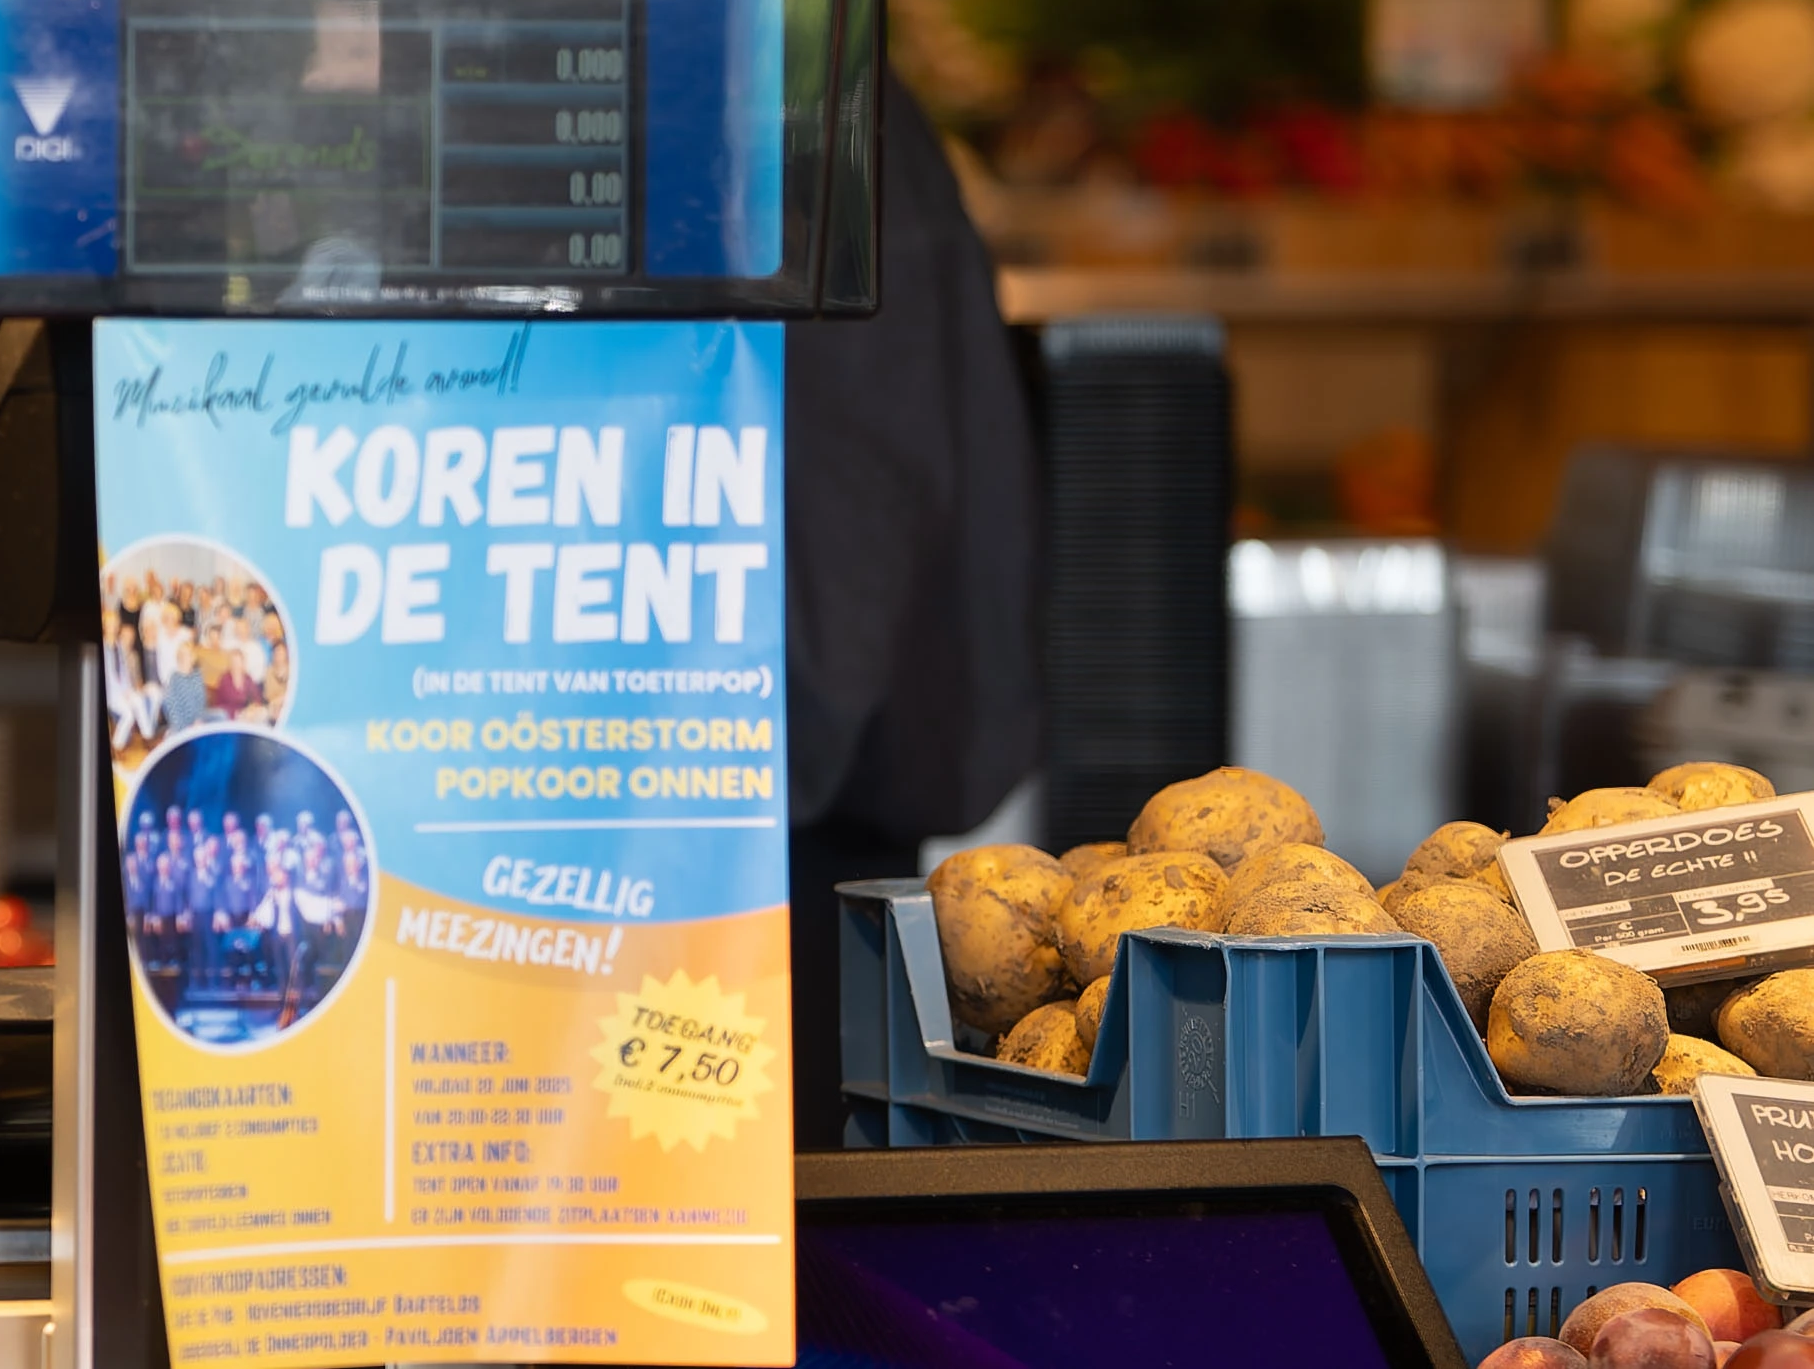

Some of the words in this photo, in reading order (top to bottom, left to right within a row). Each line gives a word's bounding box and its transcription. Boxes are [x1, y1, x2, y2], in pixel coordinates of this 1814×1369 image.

[556, 48, 622, 81] 0.000
[555, 110, 622, 144] 0.000
[569, 171, 622, 206] 0.00
[568, 233, 622, 267] 0.00
[284, 425, 626, 527] KOREN
[662, 425, 767, 527] IN
[315, 544, 450, 646] DE
[485, 544, 768, 644] TENT
[412, 667, 447, 698] (IN
[452, 671, 483, 693] DE
[488, 670, 547, 693] TENT
[553, 670, 607, 693] VAN
[612, 667, 772, 698] TOETERPOP)
[367, 721, 473, 753] KOOR
[481, 712, 773, 753] OÖSTERSTORM
[437, 767, 621, 801] POPKOOR
[629, 766, 773, 799] ONNEN
[1560, 820, 1784, 868] OPPERDOES
[482, 854, 655, 917] GEZELLIG
[1605, 868, 1642, 887] DE
[1651, 854, 1735, 878] ECHTE
[1692, 888, 1791, 925] 3,95
[397, 906, 624, 975] MEEZINGEN!
[1595, 935, 1612, 943] Per
[1637, 927, 1665, 937] gram
[633, 1006, 757, 1055] TOEGANG
[410, 1041, 510, 1064] WANNEER:
[619, 1037, 645, 1067] €
[659, 1043, 740, 1086] 7,50
[412, 1141, 475, 1165] EXTRA
[482, 1140, 532, 1164] INFO:
